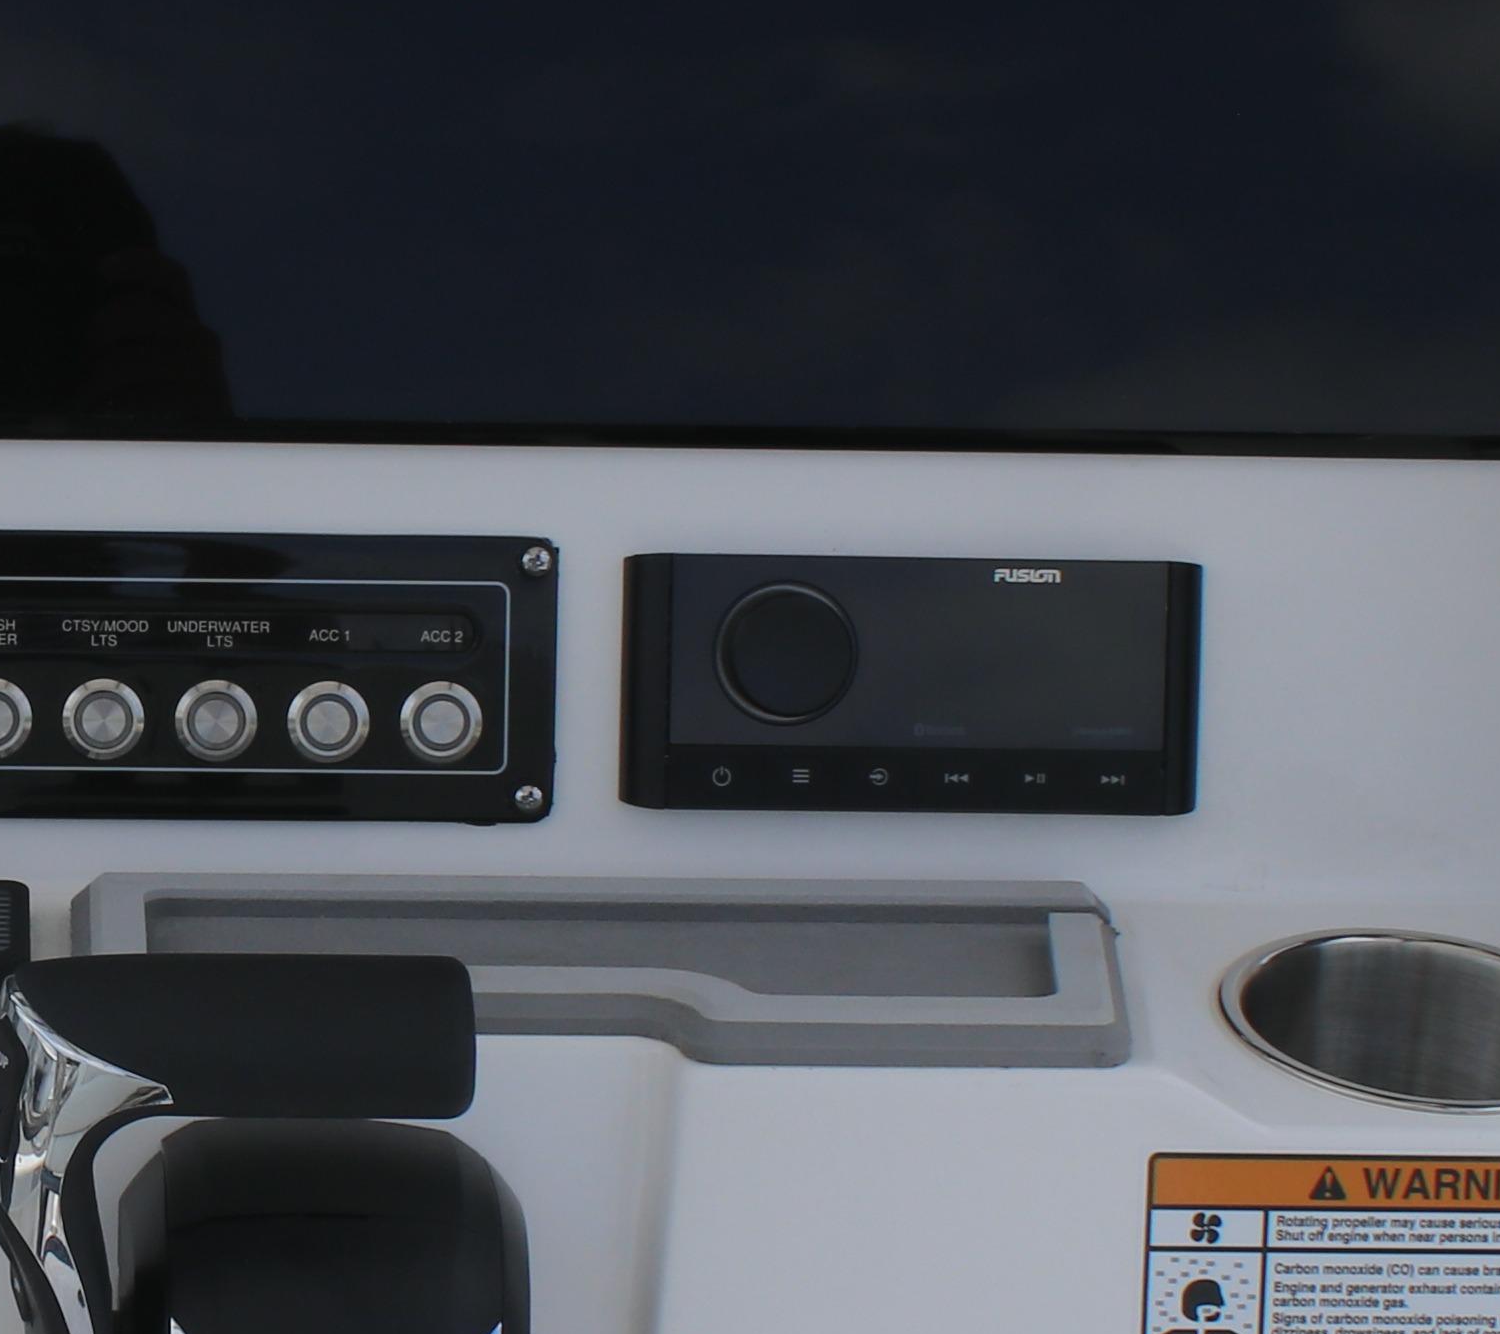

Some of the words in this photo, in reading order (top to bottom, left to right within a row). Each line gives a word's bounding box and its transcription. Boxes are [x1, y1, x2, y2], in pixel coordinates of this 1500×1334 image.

[994, 568, 1062, 583] FUSION
[61, 619, 150, 633] CTSY/MOOD
[167, 620, 271, 634] UNDERWATER
[90, 634, 118, 647] LTS
[206, 635, 234, 648] LTS
[308, 628, 340, 642] ACC
[343, 629, 351, 642] 1
[420, 629, 451, 643] ACC
[454, 630, 464, 643] 2
[1276, 1215, 1329, 1231] Rotating
[1331, 1216, 1388, 1230] propeller
[1390, 1218, 1417, 1231] may
[1418, 1218, 1457, 1229] cause
[1274, 1262, 1320, 1276] Carbon
[1322, 1264, 1384, 1276] monoxide
[1386, 1263, 1415, 1278] (CO)
[1417, 1266, 1441, 1276] can
[1442, 1266, 1481, 1277] cause
